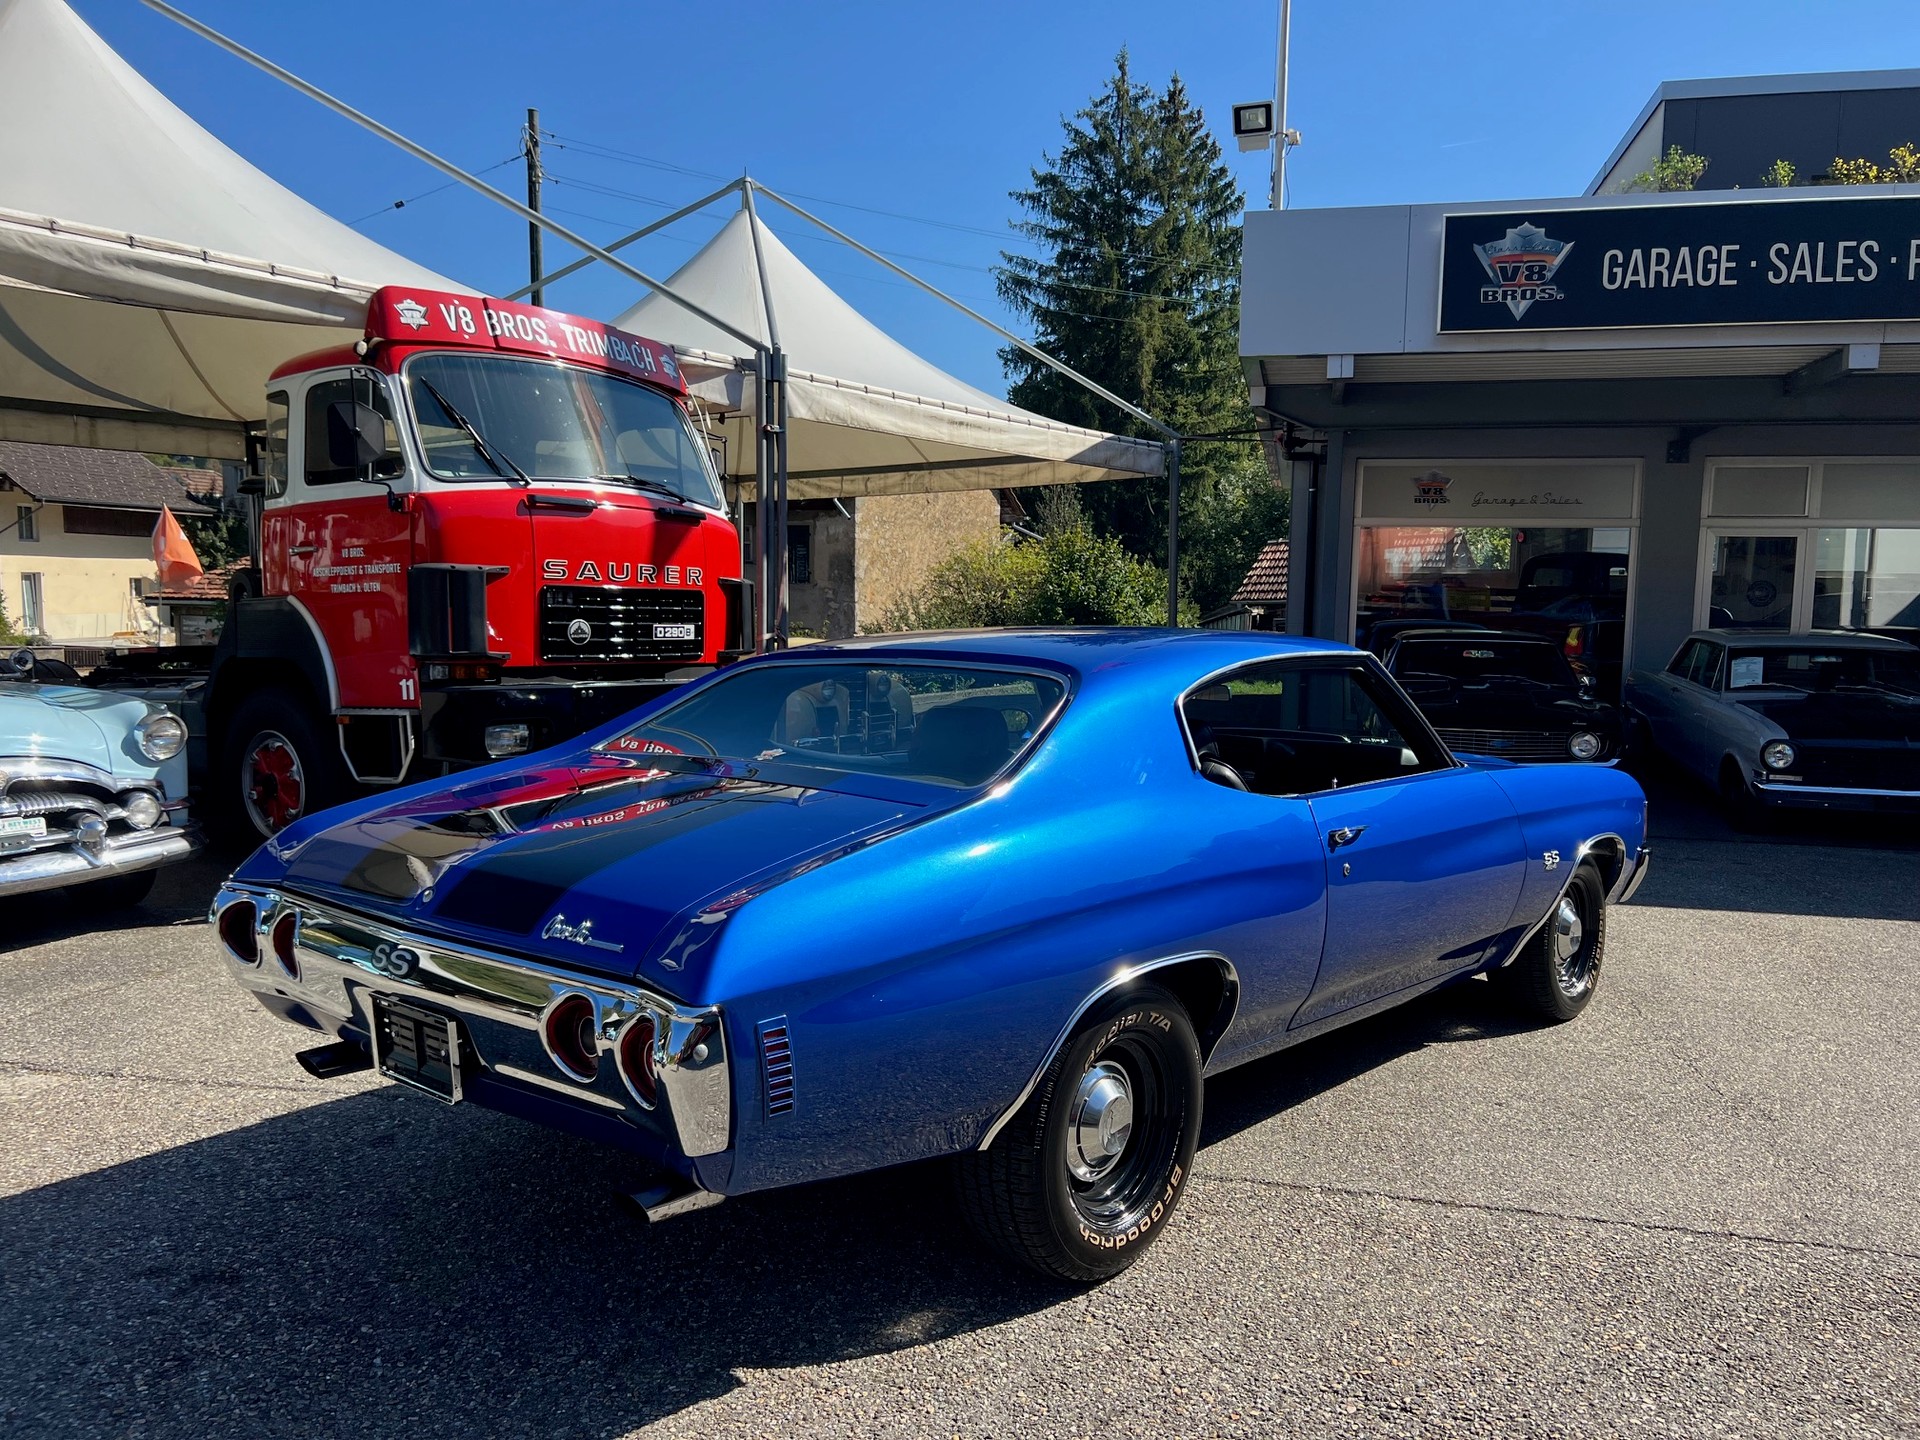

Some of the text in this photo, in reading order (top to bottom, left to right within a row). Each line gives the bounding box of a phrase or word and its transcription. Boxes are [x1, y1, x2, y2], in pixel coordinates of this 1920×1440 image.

[1496, 261, 1549, 284] V8
[1602, 245, 1740, 290] GARAGE
[1768, 240, 1880, 285] SALES
[439, 303, 476, 334] V8
[483, 309, 557, 348] BROS.
[558, 322, 657, 373] TRIMBACH
[1421, 487, 1444, 496] V8
[1471, 491, 1584, 507] Garage & Sales
[365, 563, 401, 575] TRANSPORTE
[543, 559, 704, 586] SAURER
[331, 583, 356, 593] TRIMBACH
[364, 582, 381, 593] OLTEN
[399, 678, 415, 701] 11
[620, 738, 639, 749] V8
[372, 943, 413, 976] SS
[1149, 1011, 1172, 1033] T/A
[1080, 1163, 1183, 1250] BFGoodrich
